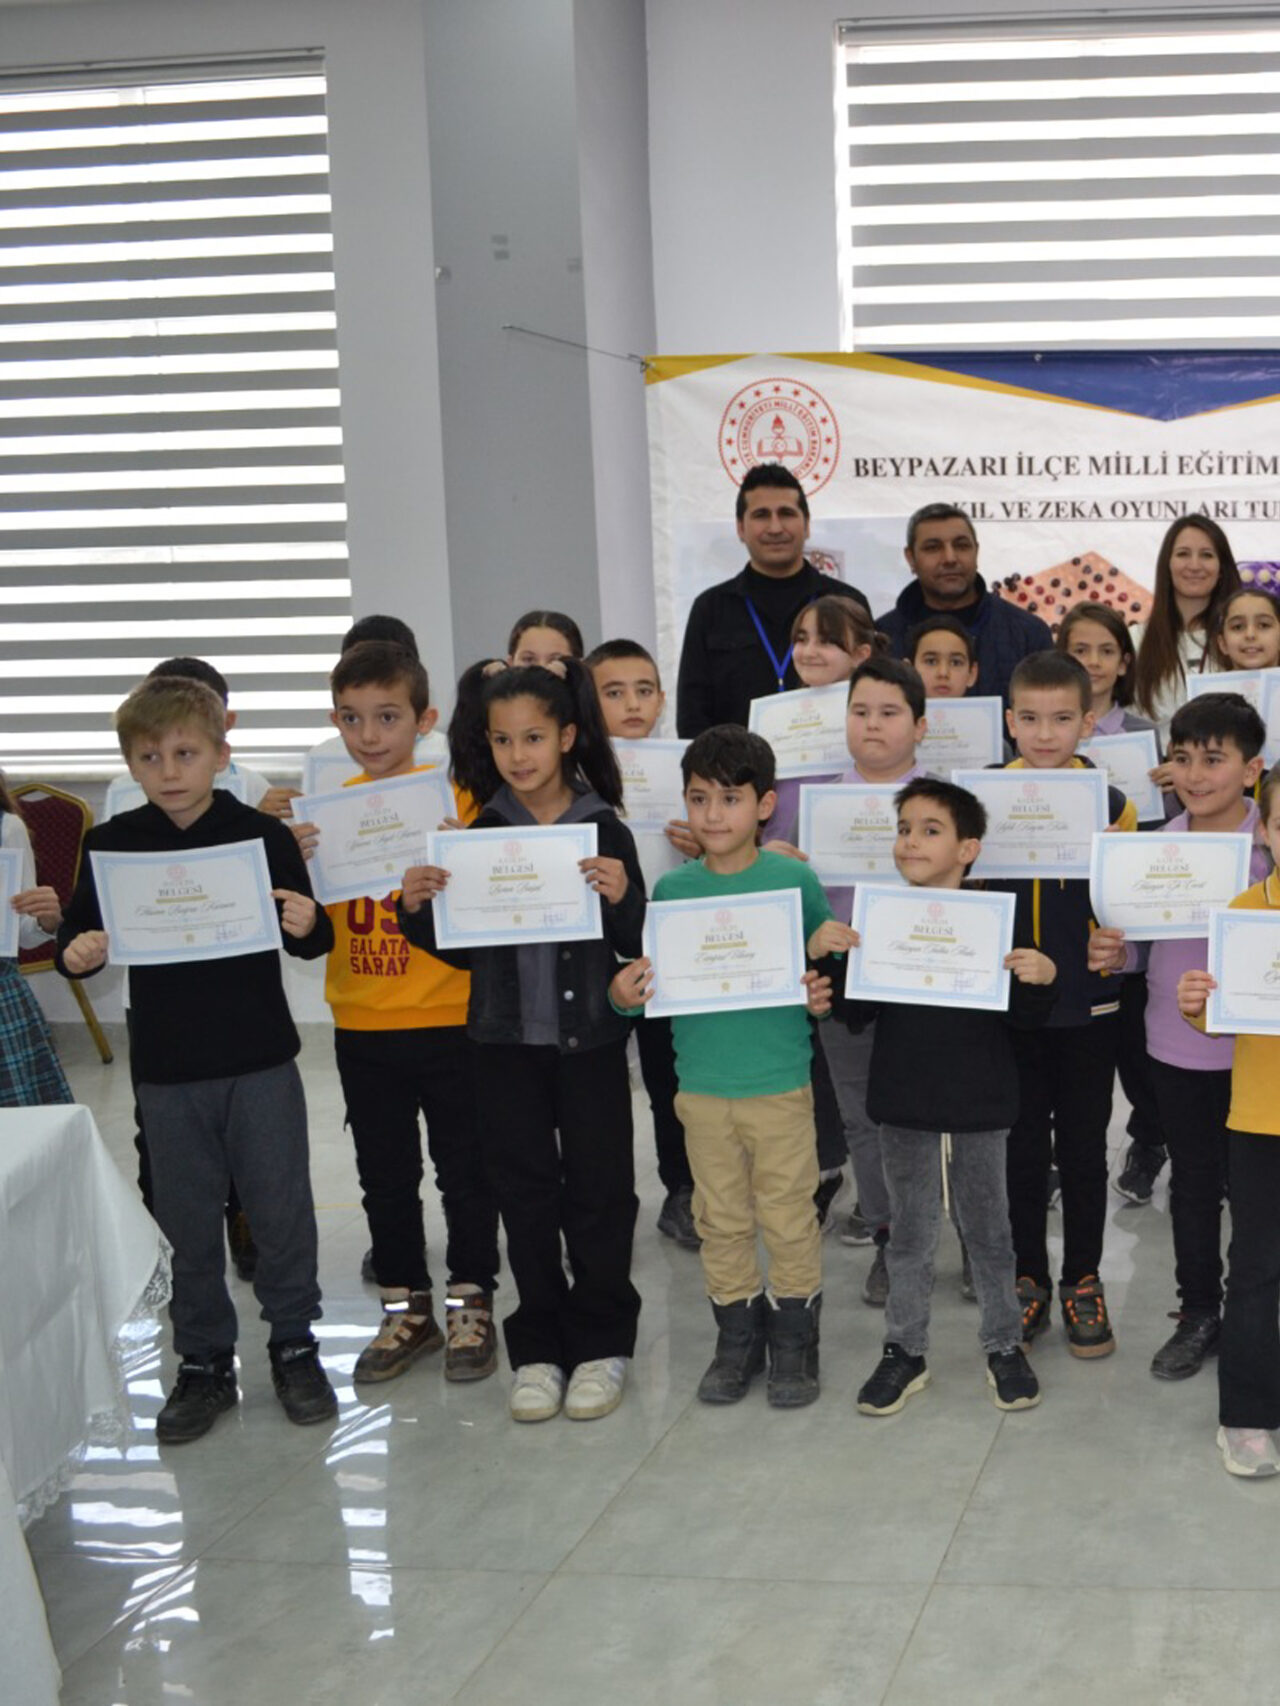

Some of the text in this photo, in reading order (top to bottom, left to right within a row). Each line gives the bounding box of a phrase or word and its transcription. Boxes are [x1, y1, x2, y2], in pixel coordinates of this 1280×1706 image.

[854, 456, 1007, 478] BEYPAZARI
[1017, 451, 1080, 480] İLÇE
[1088, 451, 1168, 476] MİLLİ
[1177, 450, 1279, 476] EĞİTİM
[953, 501, 993, 519] KIL
[1001, 501, 1031, 519] VE
[1038, 501, 1102, 519] ZEKA
[1111, 500, 1237, 518] OYUNLARI
[351, 938, 410, 955] GALATA
[350, 957, 410, 976] SARAY
